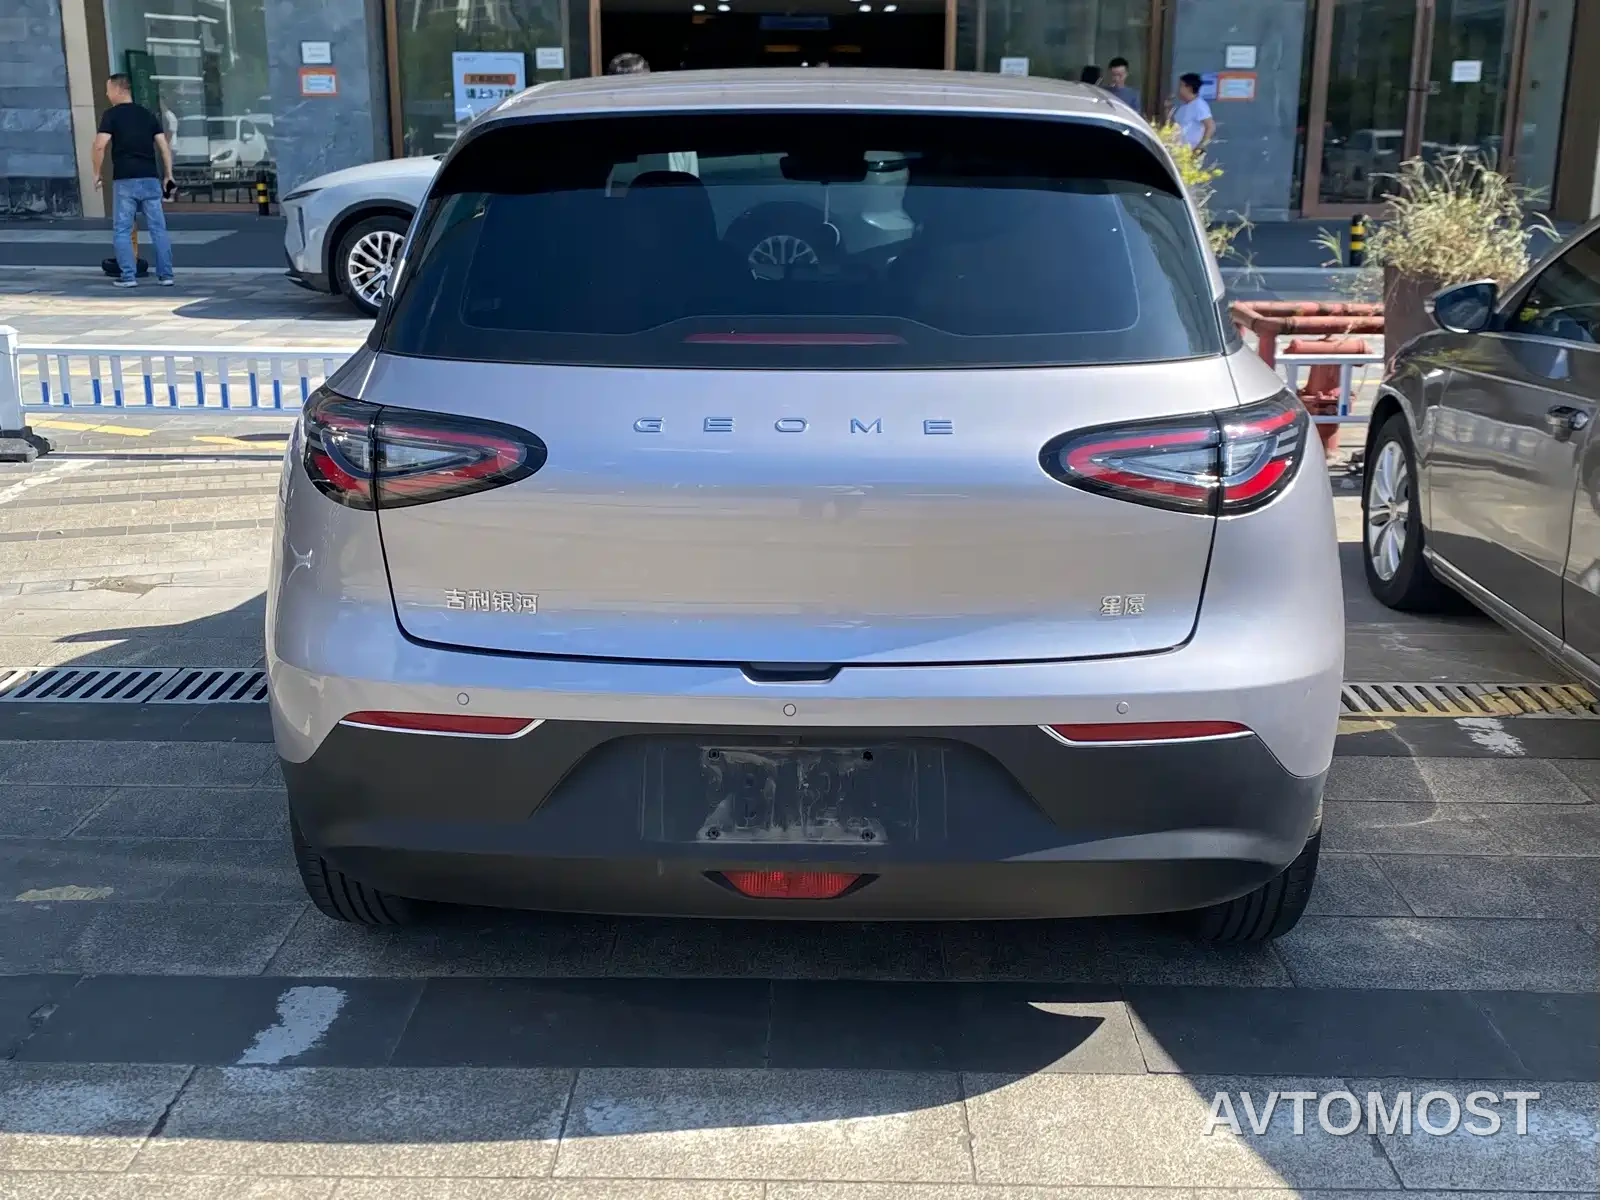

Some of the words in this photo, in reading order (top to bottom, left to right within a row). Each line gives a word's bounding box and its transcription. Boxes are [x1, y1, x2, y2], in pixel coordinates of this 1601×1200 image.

[633, 416, 956, 436] GEOME
[444, 588, 539, 615] 吉利银河
[1100, 593, 1147, 617] 星愿
